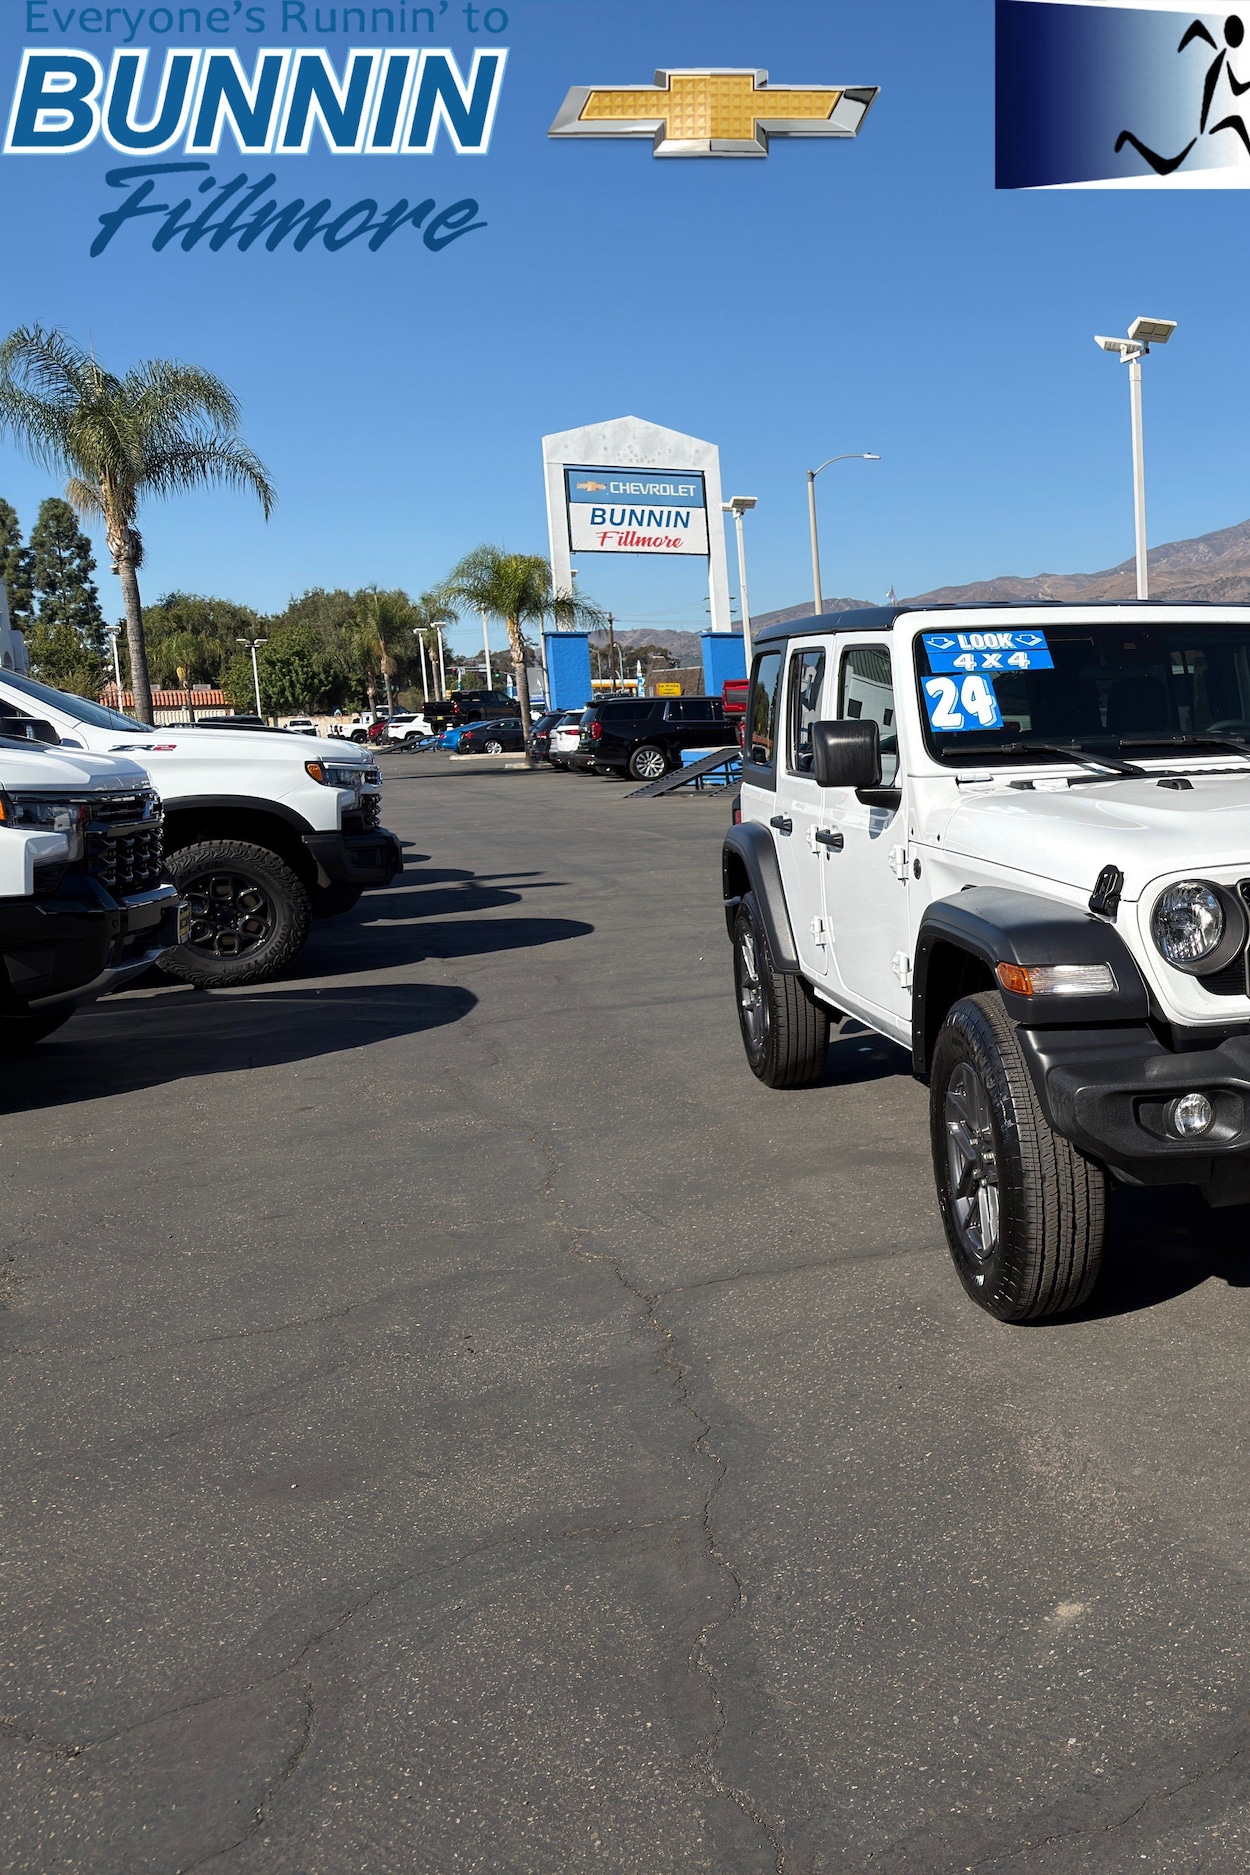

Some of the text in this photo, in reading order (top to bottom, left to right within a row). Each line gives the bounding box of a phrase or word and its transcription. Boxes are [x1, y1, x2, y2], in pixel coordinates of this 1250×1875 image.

[609, 481, 696, 496] CHEVROLET
[590, 507, 690, 529] BUNNIN
[595, 530, 684, 549] Fillmore
[957, 633, 1017, 651] LOOK
[925, 675, 997, 729] 24
